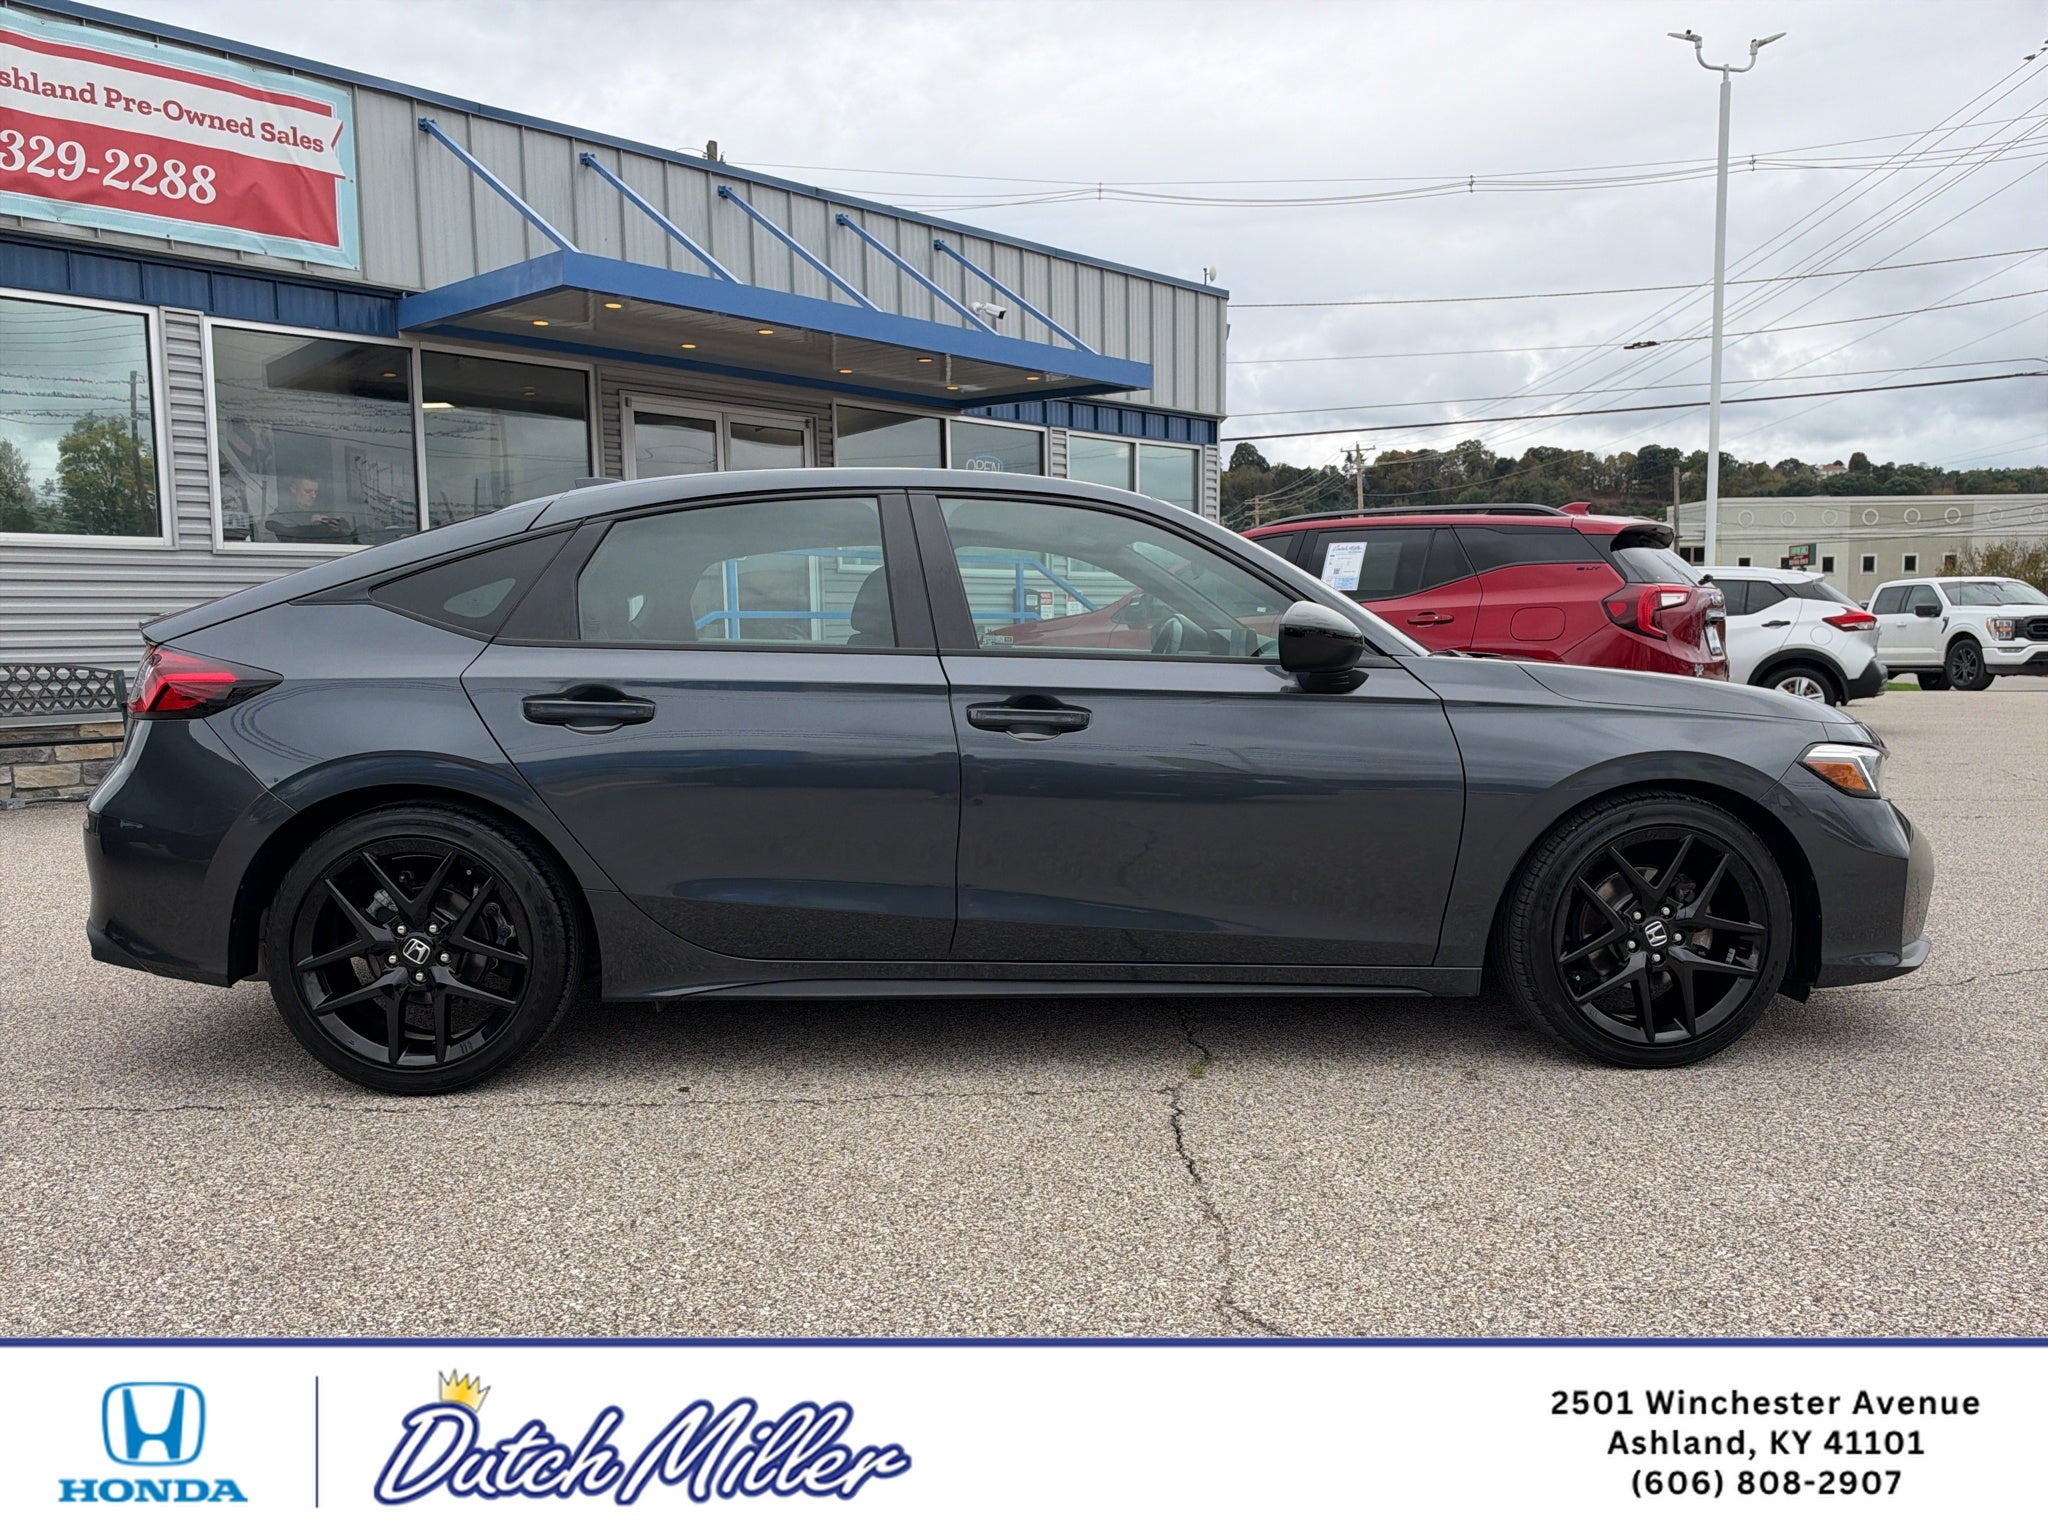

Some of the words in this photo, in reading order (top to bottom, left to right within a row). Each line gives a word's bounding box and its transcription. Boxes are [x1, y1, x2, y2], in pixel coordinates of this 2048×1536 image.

[0, 66, 98, 105] shland
[103, 86, 255, 139] Pre-Owned
[260, 121, 325, 153] Sales
[0, 129, 217, 205] 329-2288
[966, 458, 1001, 473] OPEN
